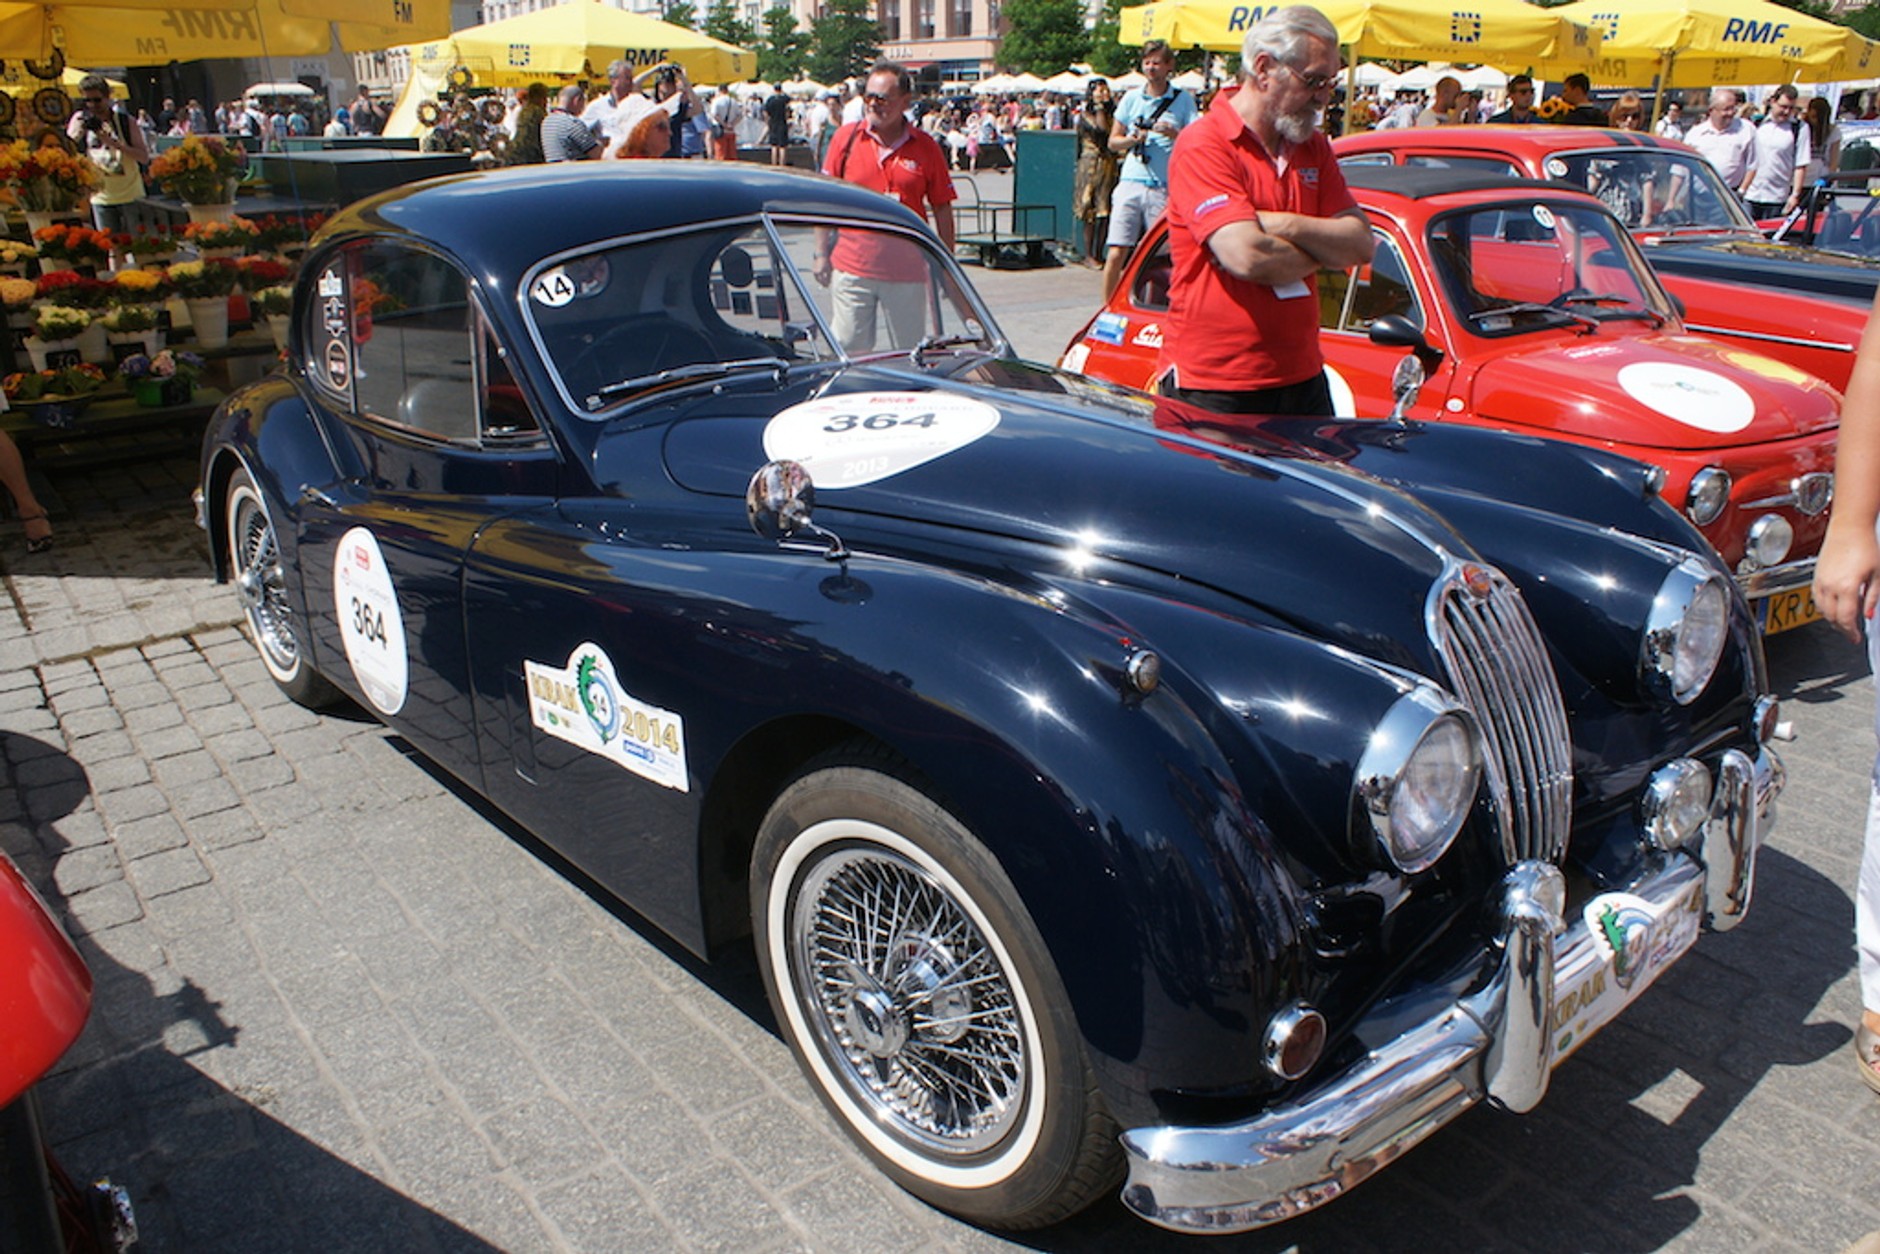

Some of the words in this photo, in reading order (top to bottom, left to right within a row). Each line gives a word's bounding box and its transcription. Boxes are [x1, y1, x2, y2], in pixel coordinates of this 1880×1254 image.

[394, 0, 413, 23] FM
[1722, 18, 1789, 43] RMF
[625, 48, 669, 66] RMF
[538, 276, 571, 302] 14
[823, 412, 939, 433] 364
[842, 456, 889, 480] 2013
[352, 596, 387, 650] 364
[1769, 593, 1801, 630] KR
[619, 705, 680, 755] 2014
